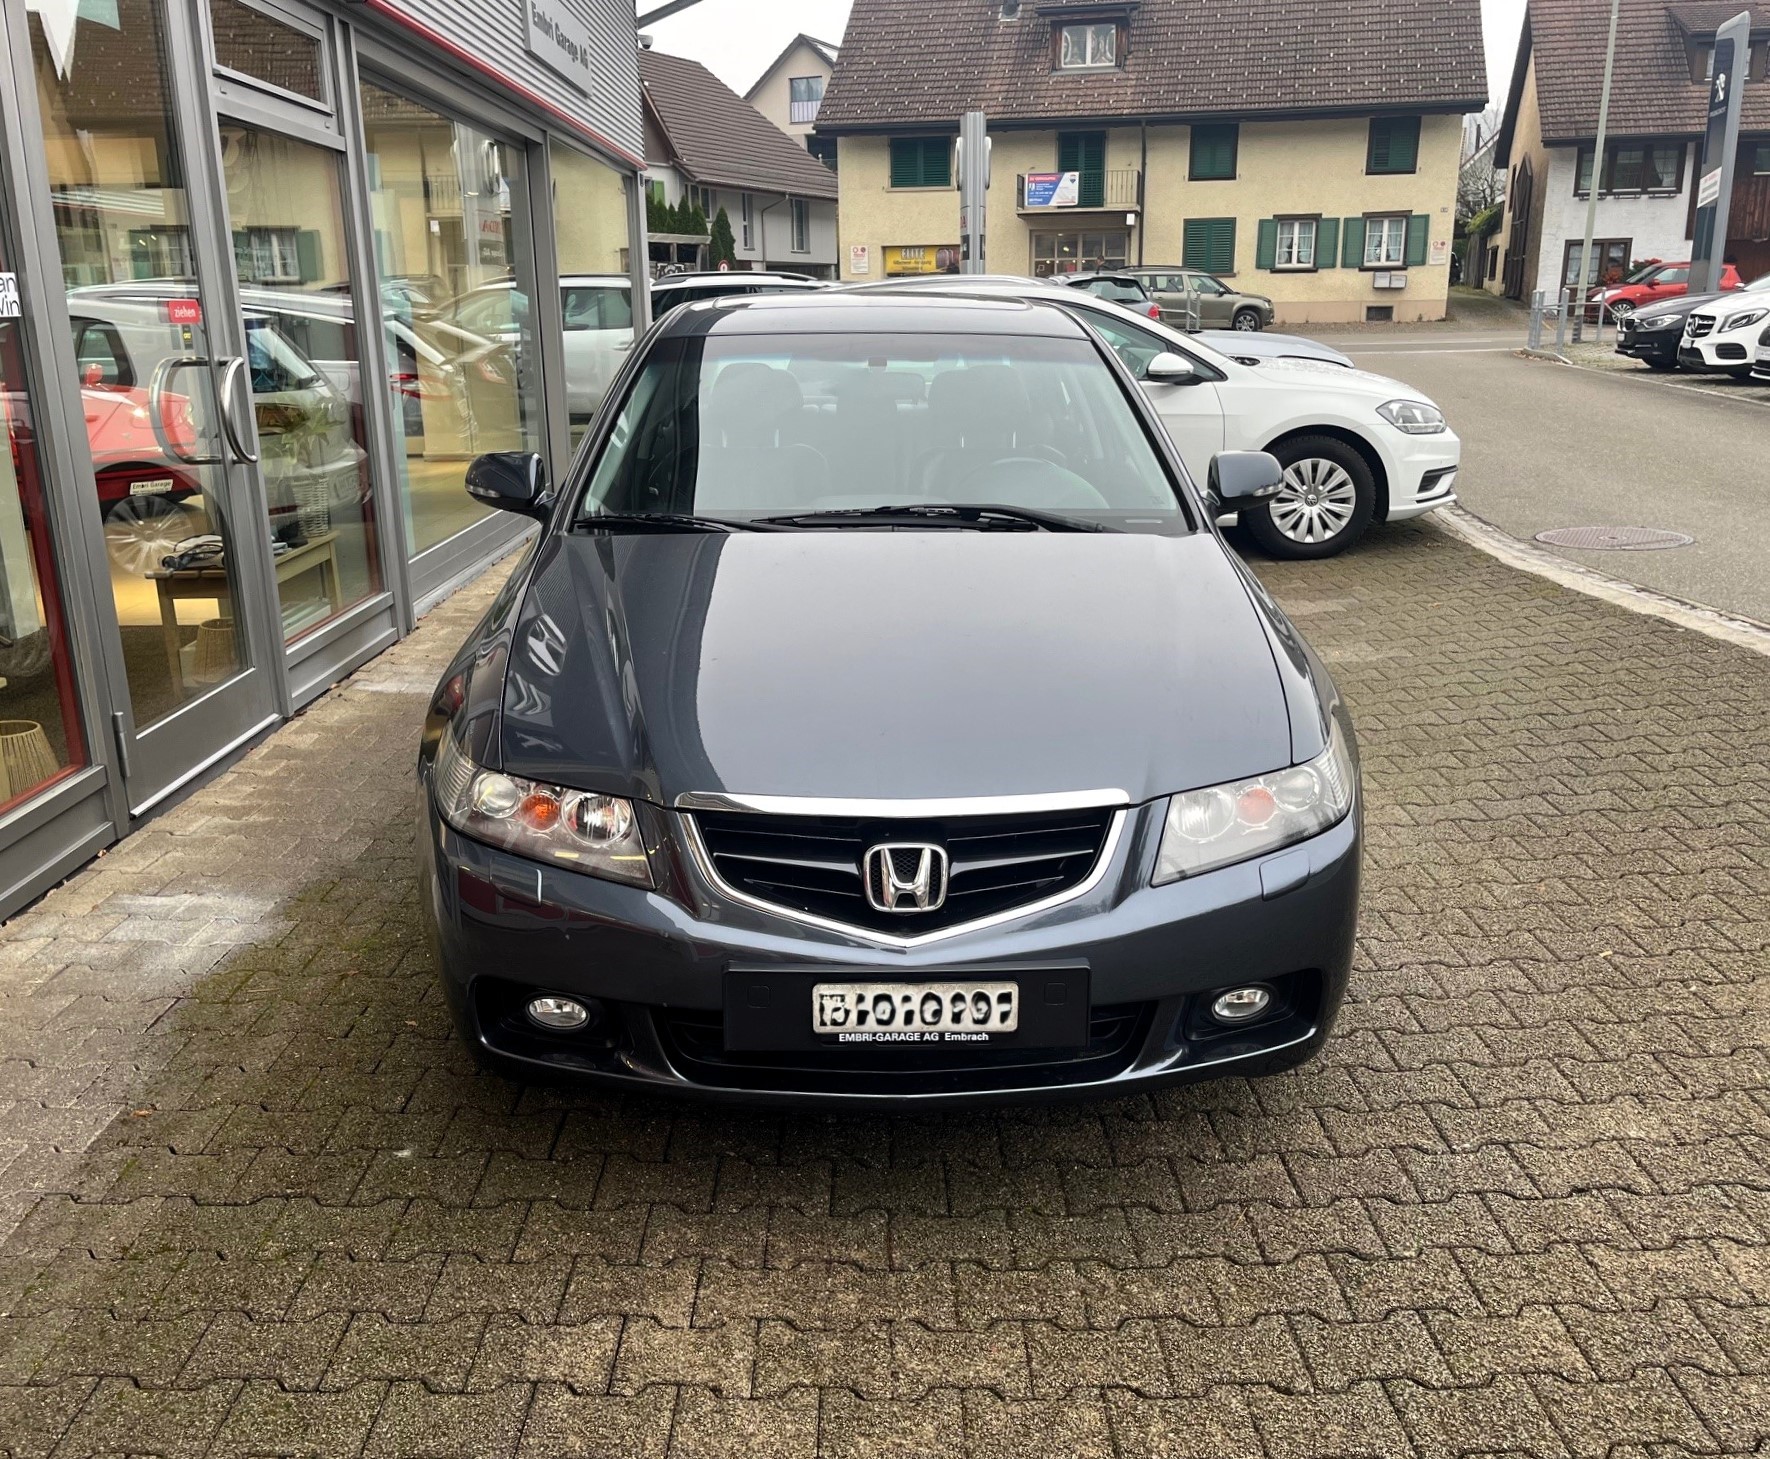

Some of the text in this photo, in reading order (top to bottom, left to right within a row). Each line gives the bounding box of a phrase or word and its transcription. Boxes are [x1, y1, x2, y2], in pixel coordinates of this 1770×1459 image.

[531, 1, 554, 41] Embri
[555, 22, 578, 63] Garage
[901, 247, 924, 260] ELITE
[174, 305, 196, 318] ziehen
[839, 1032, 989, 1042] EMBRI-GARAGE AG Embrach
